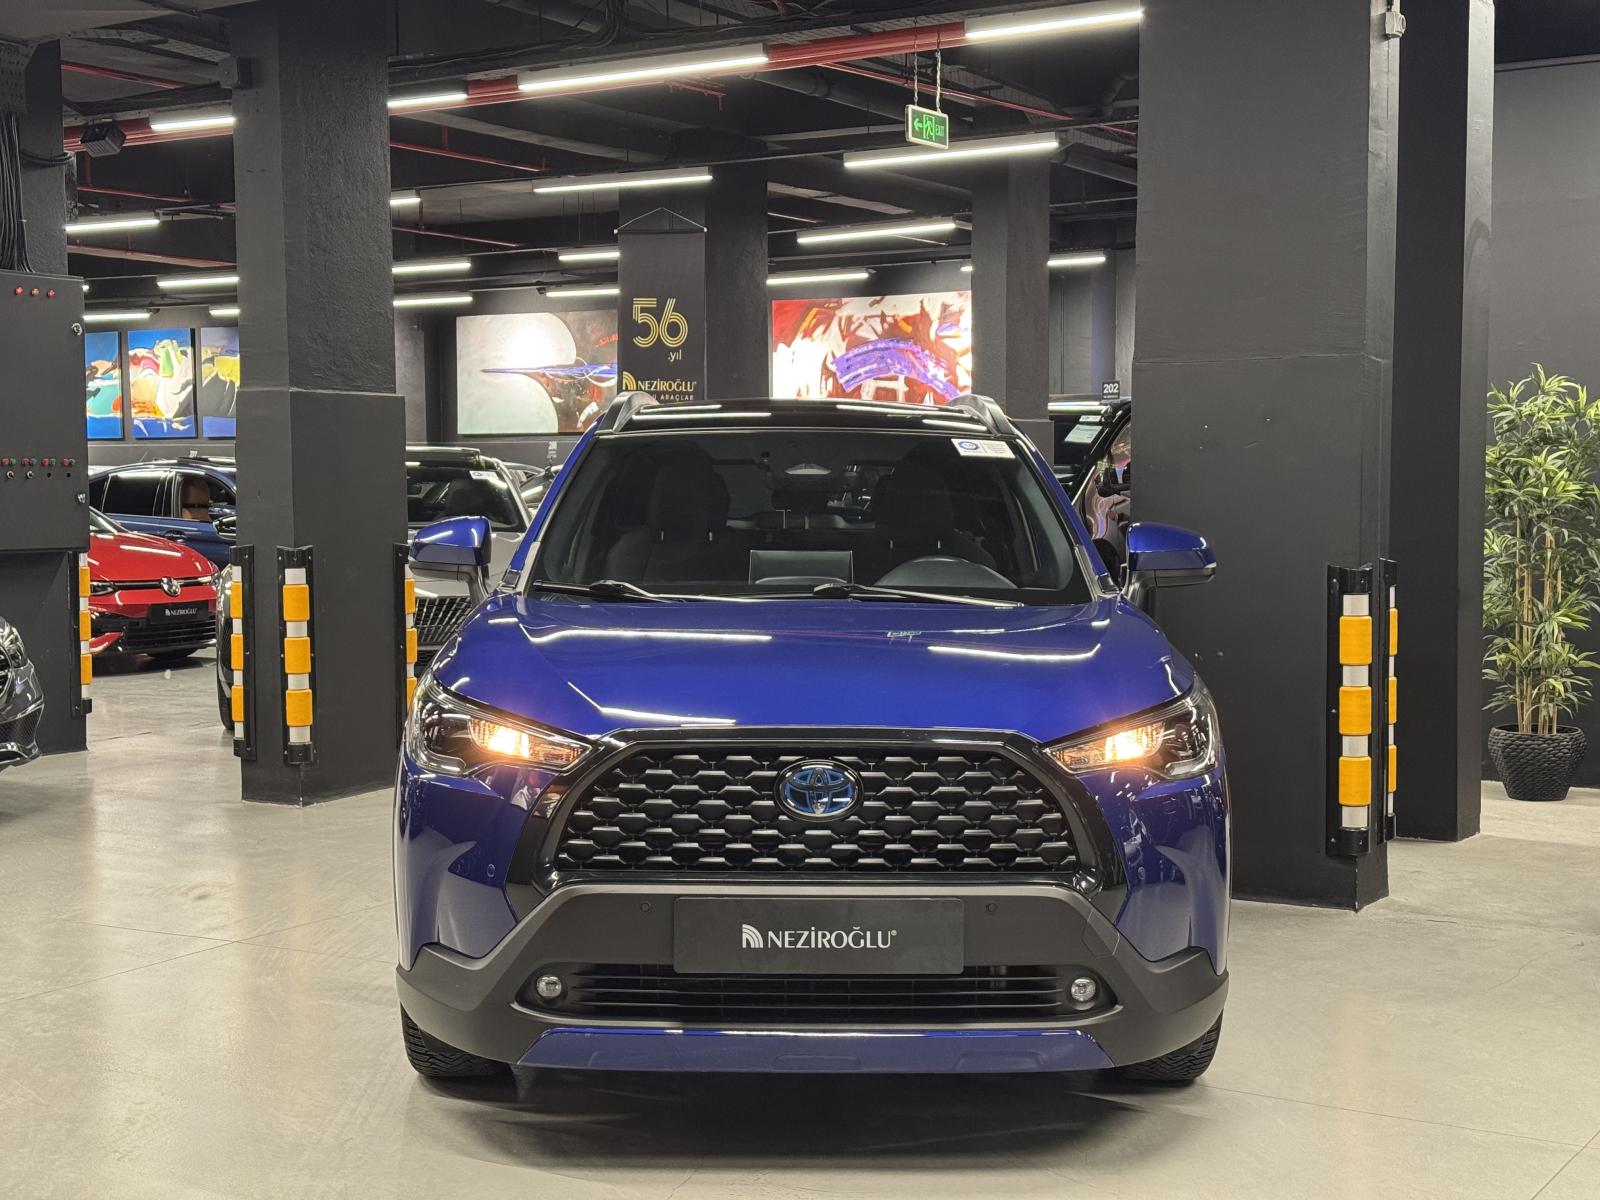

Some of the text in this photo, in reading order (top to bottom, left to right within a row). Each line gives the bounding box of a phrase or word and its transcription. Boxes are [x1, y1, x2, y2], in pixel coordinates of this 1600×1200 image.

[632, 298, 688, 347] 56
[1103, 383, 1119, 393] 202
[768, 926, 891, 949] NEZİROĞLU
